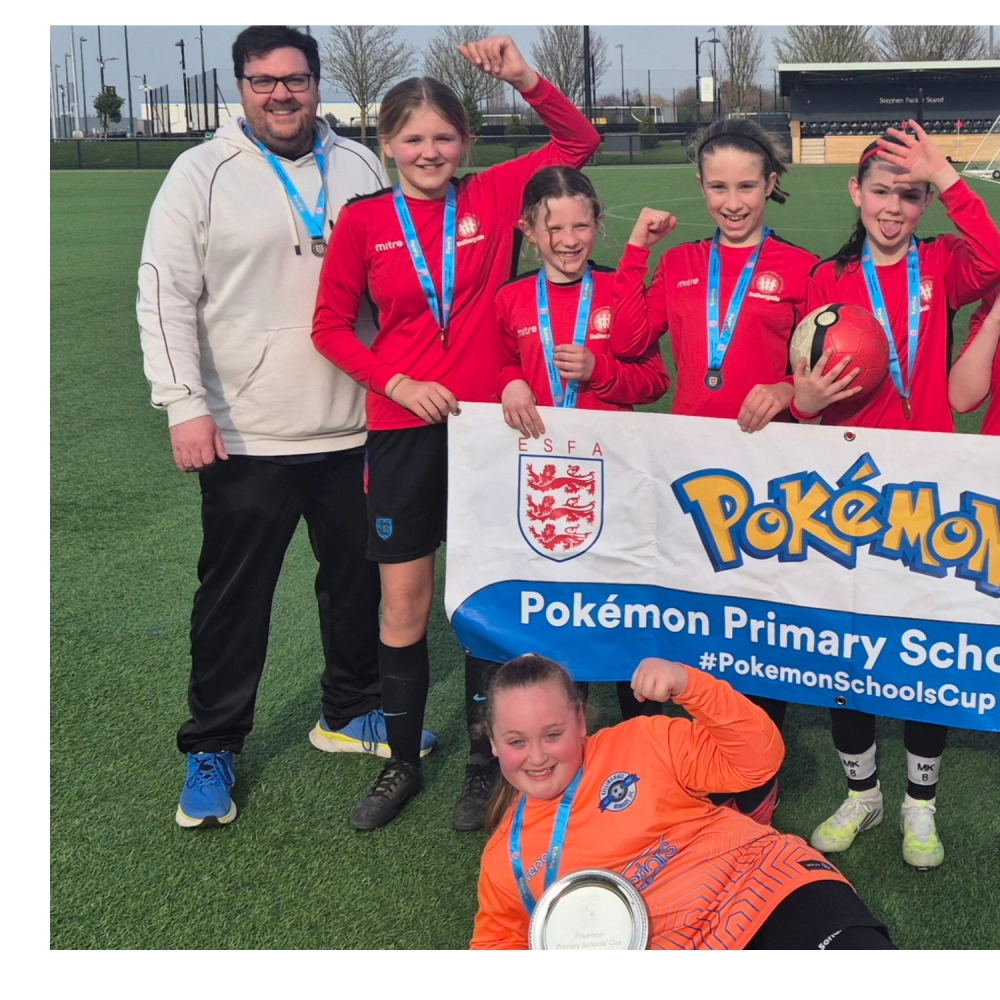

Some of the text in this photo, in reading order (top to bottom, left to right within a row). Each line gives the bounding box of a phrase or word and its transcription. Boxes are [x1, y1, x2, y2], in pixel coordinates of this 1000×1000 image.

[375, 240, 403, 252] mitre
[677, 278, 699, 288] mitre
[520, 591, 709, 636] Pokémon
[724, 606, 887, 670] Primary
[699, 652, 997, 715] #PokemonSchoolsCup
[843, 759, 860, 768] MK
[917, 763, 935, 771] MK
[922, 773, 929, 781] 8
